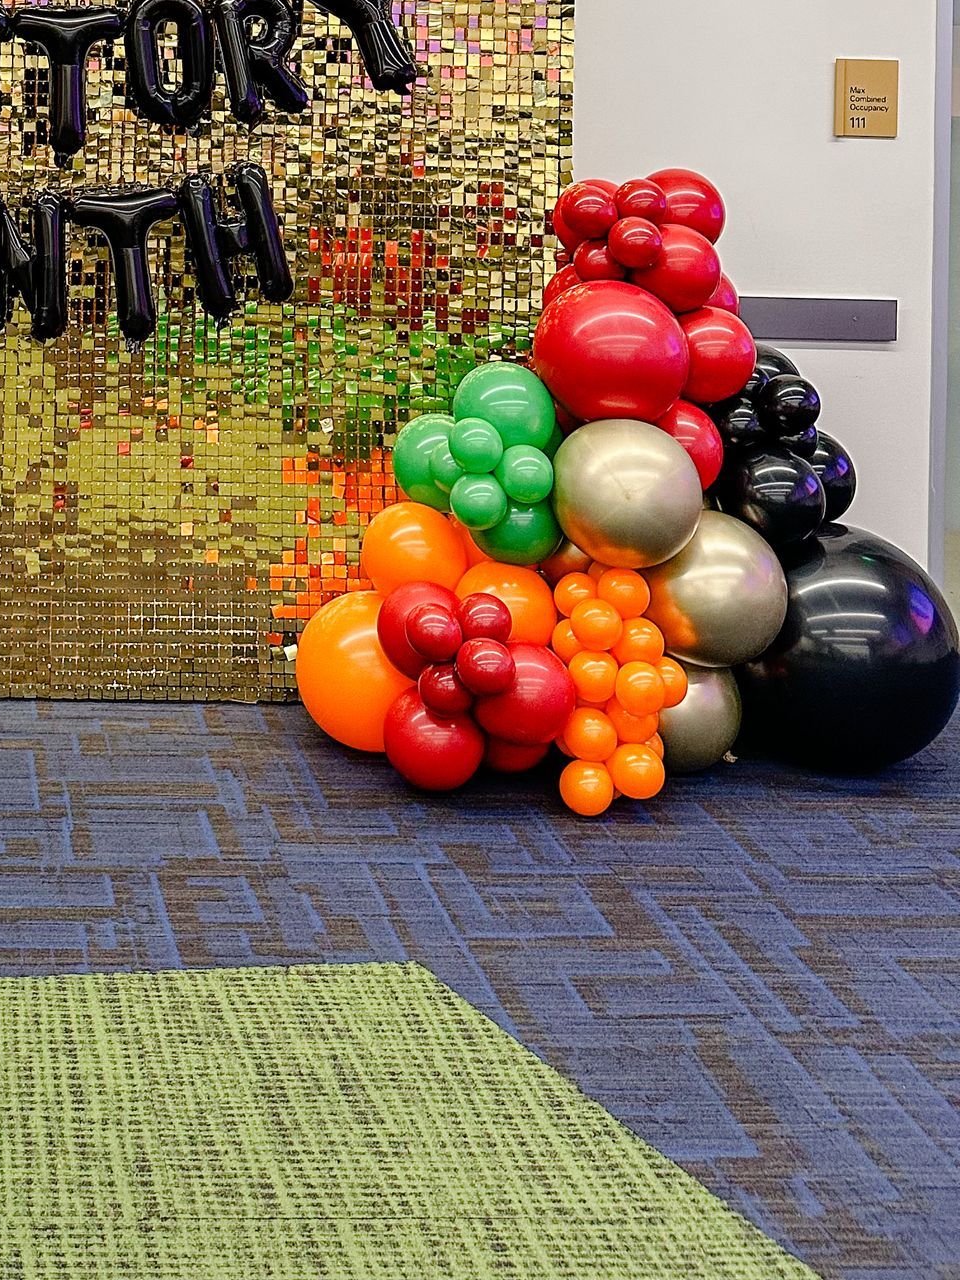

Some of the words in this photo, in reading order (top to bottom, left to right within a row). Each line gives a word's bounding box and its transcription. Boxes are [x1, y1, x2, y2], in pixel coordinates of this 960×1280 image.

[849, 95, 887, 103] Combined
[849, 103, 889, 113] Occupancy
[849, 117, 866, 129] 111
